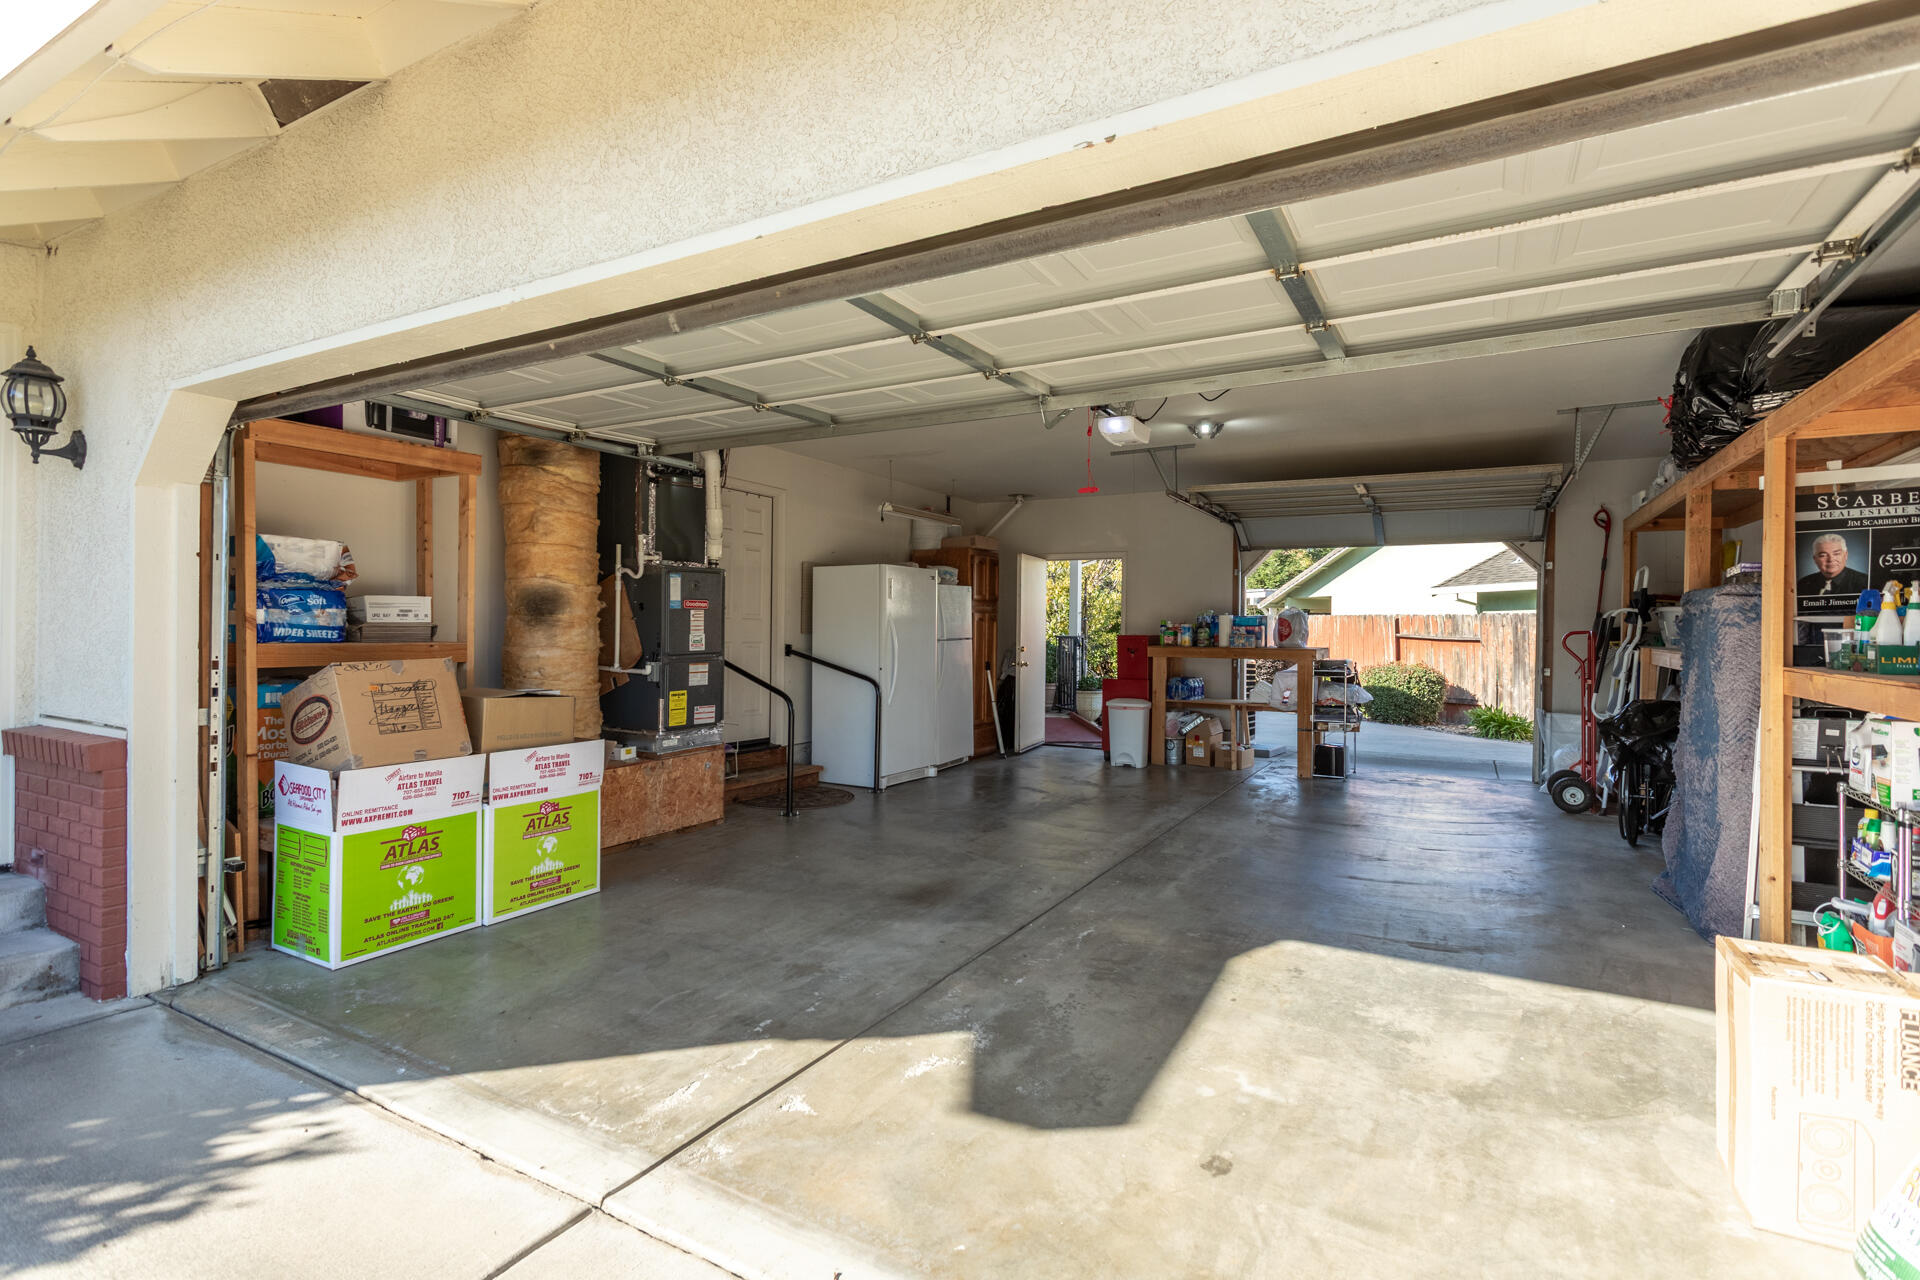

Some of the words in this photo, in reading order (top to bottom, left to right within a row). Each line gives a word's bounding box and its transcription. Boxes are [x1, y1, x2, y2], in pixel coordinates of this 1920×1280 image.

[1820, 510, 1855, 519] REAL
[1860, 506, 1909, 516] ESTATE
[1862, 517, 1909, 526] SCARBERRY
[1878, 553, 1917, 568] (530)
[273, 627, 305, 637] WIDER
[306, 629, 339, 639] SHEETS
[263, 716, 283, 725] The
[552, 760, 570, 768] TRAVEL
[579, 772, 592, 780] 7107
[397, 781, 418, 790] ATLAS
[419, 778, 442, 787] TRAVEL
[510, 782, 537, 791] REMITTANCE
[290, 782, 312, 797] SEAFOOD
[313, 787, 326, 800] CITY
[452, 791, 470, 800] 7107
[341, 809, 363, 818] ONLINE
[364, 804, 399, 814] REMITTANCE
[341, 809, 414, 827] WWW.AXPREMIT.COM
[526, 811, 570, 832] ATLAS
[384, 836, 440, 860] ATLAS
[510, 878, 524, 886] SAVE
[510, 894, 526, 903] ATLAS
[527, 889, 545, 897] ONLINE
[546, 882, 570, 892] TRACKING
[363, 915, 381, 924] SAVE
[397, 905, 419, 915] EARTH!
[433, 895, 455, 905] GREEN!
[363, 933, 385, 943] ATLAS
[386, 926, 410, 937] ONLINE
[411, 917, 441, 929] TRACKING
[442, 913, 455, 921] 24/7
[1900, 1007, 1920, 1093] FLUANCE
